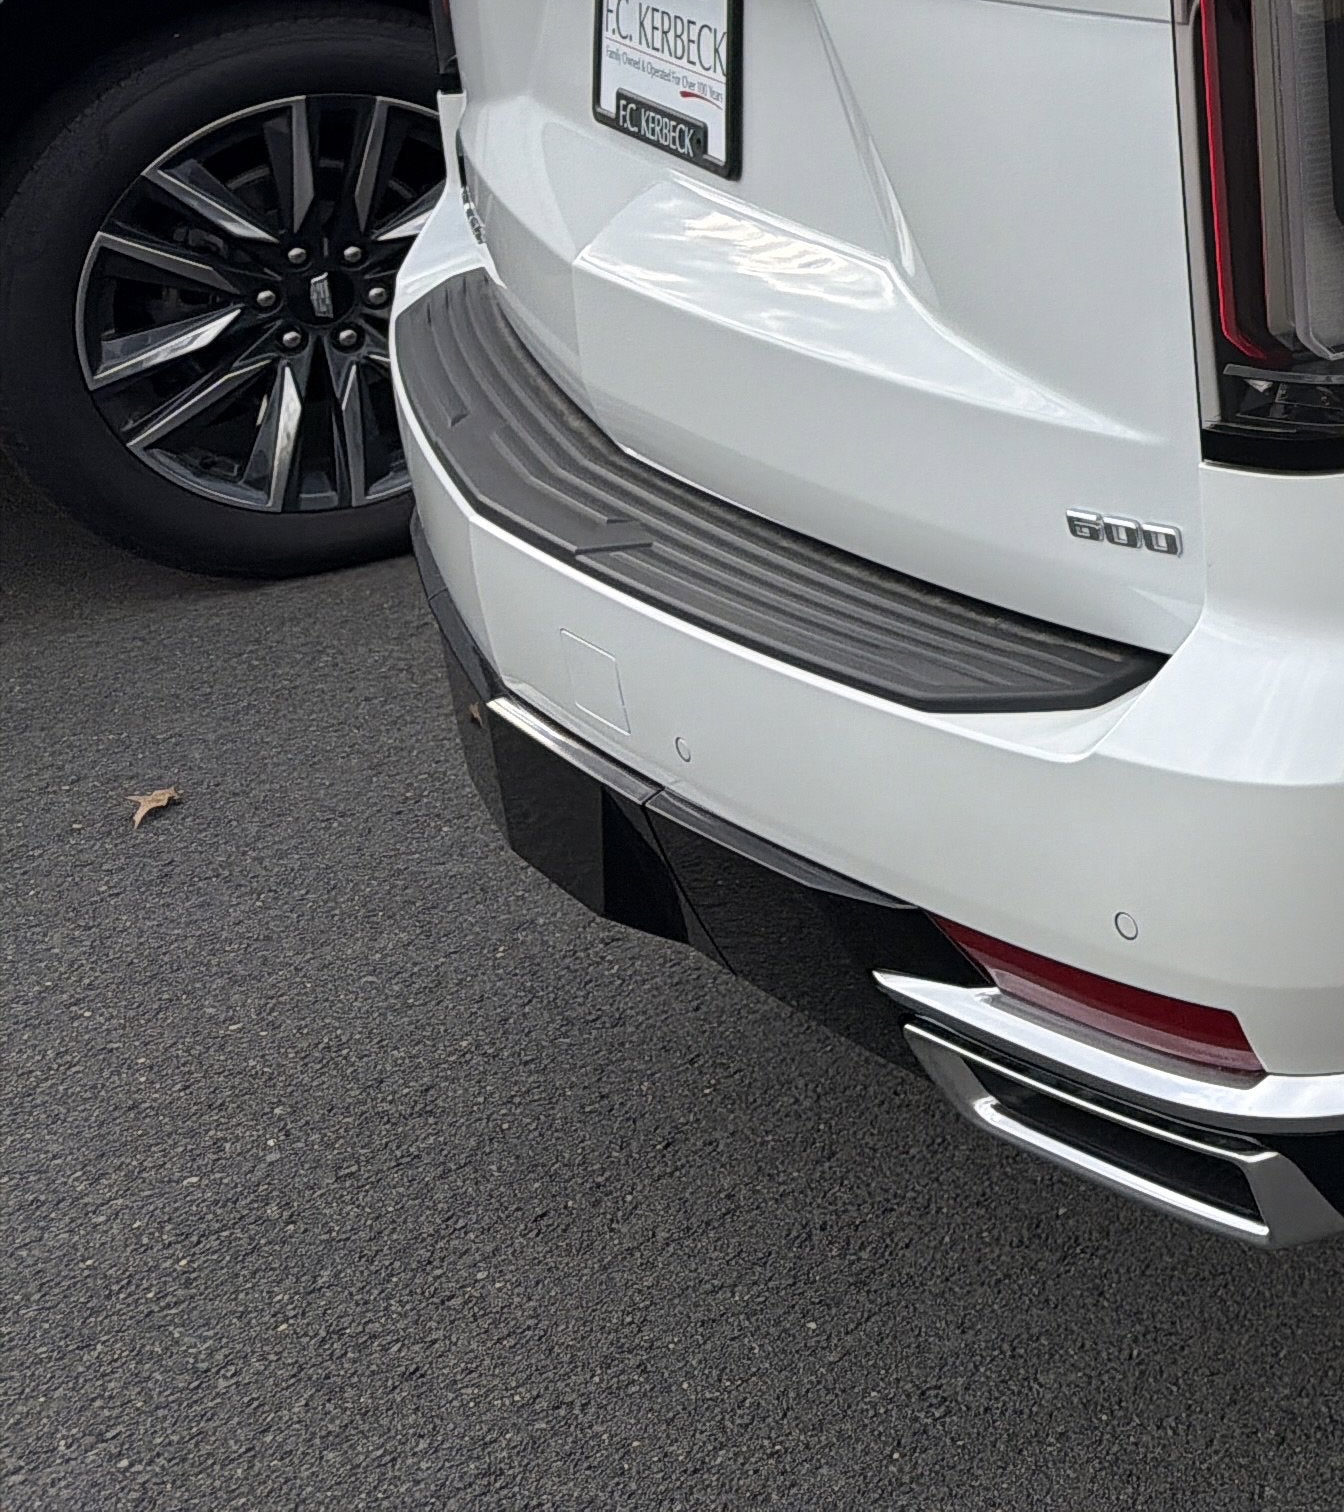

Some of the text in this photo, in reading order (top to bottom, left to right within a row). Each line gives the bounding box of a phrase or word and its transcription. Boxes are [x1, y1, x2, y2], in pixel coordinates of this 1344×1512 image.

[637, 1, 728, 77] KERBECK
[646, 61, 672, 83] Operated
[681, 75, 696, 91] Over
[640, 108, 694, 158] KERBECK
[1065, 506, 1184, 558] 600
